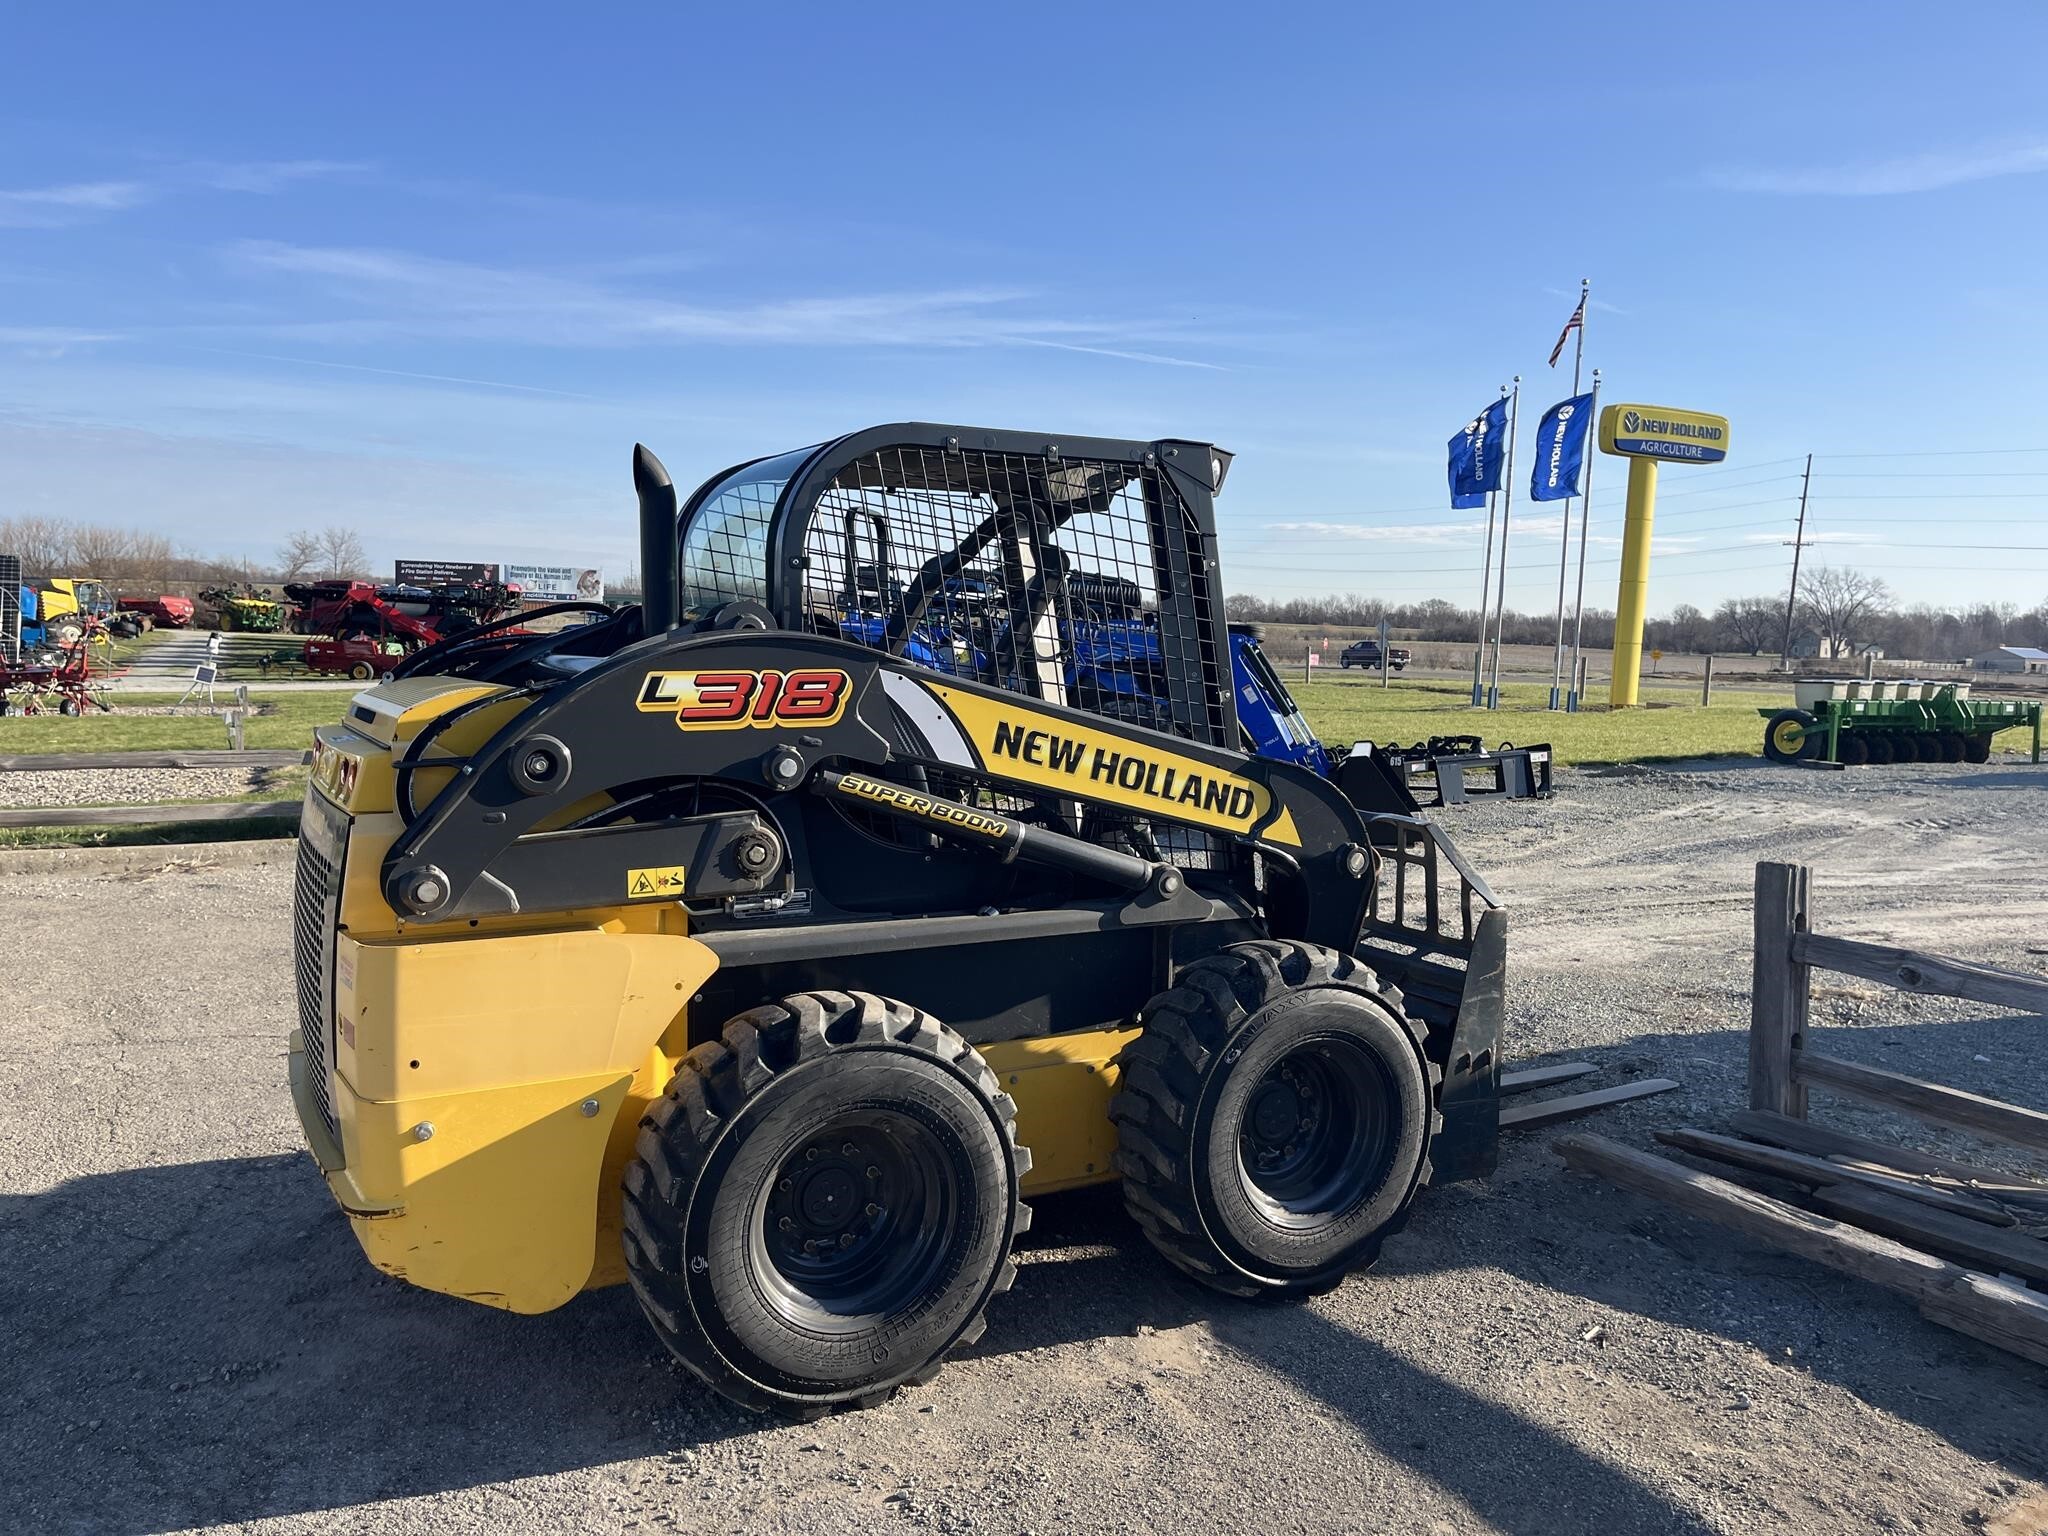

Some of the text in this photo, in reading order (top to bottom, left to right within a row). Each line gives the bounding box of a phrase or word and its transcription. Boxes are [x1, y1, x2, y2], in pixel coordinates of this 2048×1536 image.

[1642, 418, 1722, 440] NEW HOLLAND
[1475, 439, 1484, 481] HOLLAND
[1548, 421, 1567, 487] NEW HOLLAND
[1640, 441, 1703, 457] AGRICULTURE
[401, 562, 433, 570] Surrendering
[511, 565, 537, 573] Promoting
[538, 583, 557, 591] LIFE
[638, 672, 850, 727] L318
[992, 720, 1255, 820] NEW HOLLAND
[1389, 756, 1402, 767] 615
[839, 775, 1008, 838] SUPER BOOM
